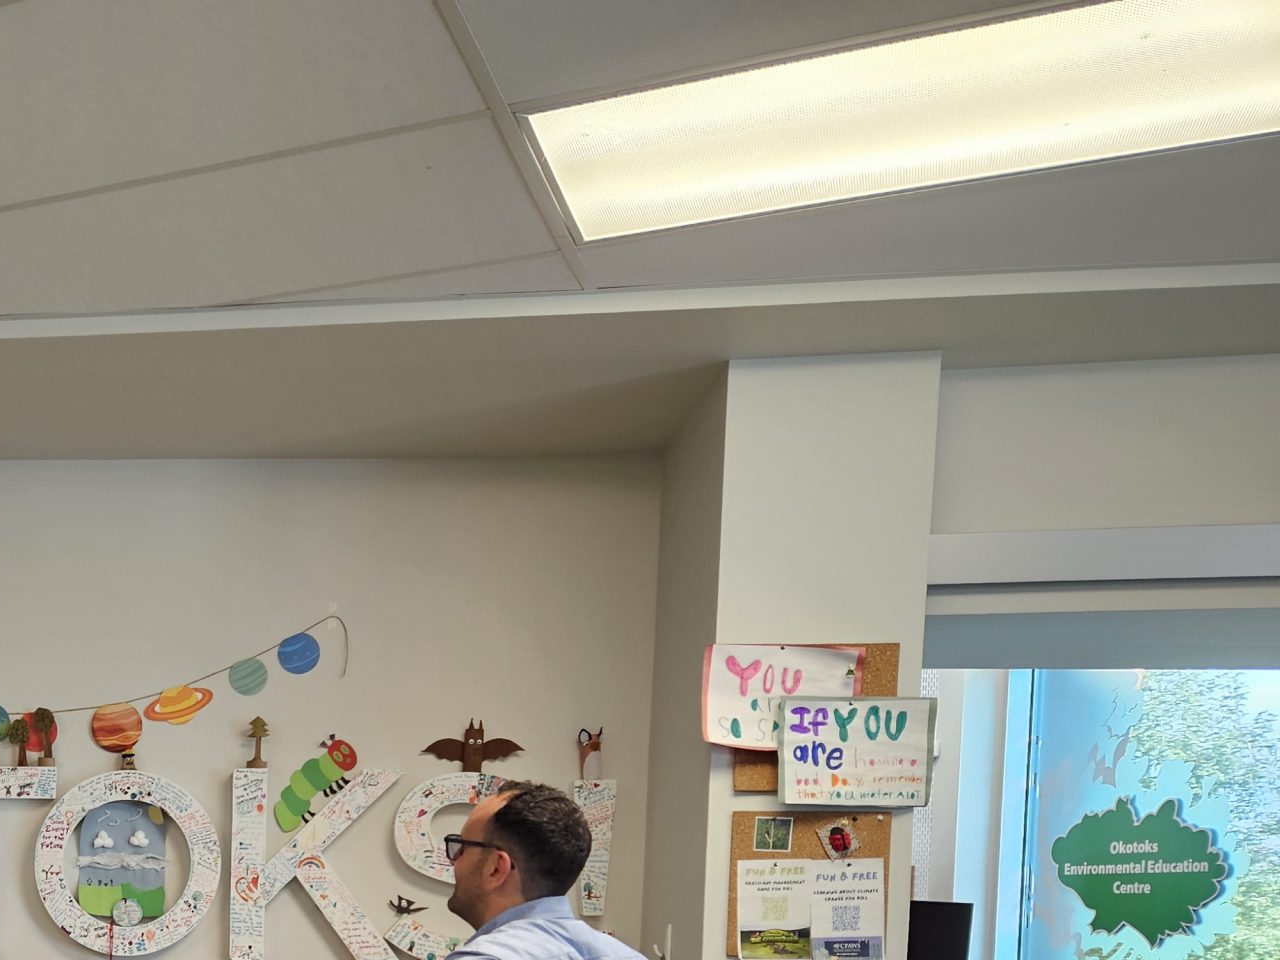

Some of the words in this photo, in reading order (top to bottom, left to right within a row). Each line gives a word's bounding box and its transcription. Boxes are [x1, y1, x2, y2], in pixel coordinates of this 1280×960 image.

[725, 655, 803, 697] YOU
[789, 706, 829, 737] If
[833, 705, 908, 743] YOU
[793, 741, 844, 771] are
[1109, 840, 1159, 855] Okotoks
[780, 866, 806, 876] FREE
[1063, 860, 1146, 876] Environmental
[1146, 860, 1209, 874] Education
[815, 873, 837, 883] FUN
[852, 871, 879, 881] FREE
[1112, 881, 1151, 894] Centre
